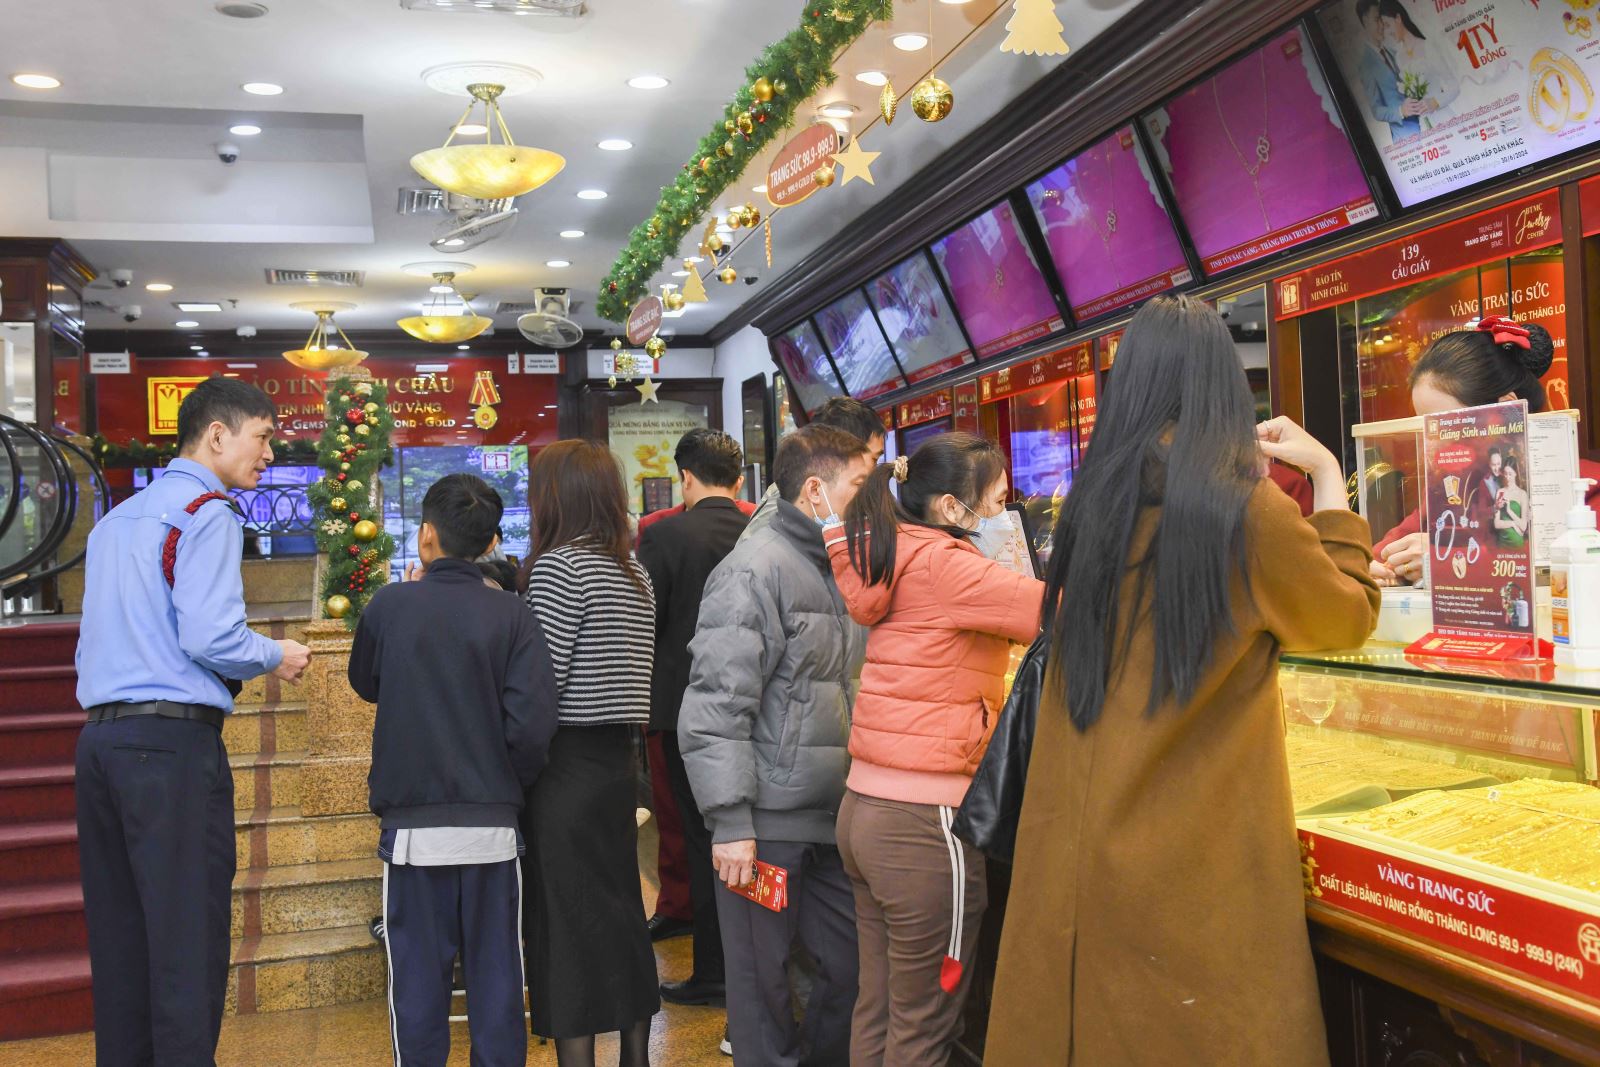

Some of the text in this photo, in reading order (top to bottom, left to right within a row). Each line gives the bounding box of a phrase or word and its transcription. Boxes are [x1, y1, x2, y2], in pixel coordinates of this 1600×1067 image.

[1479, 128, 1488, 143] 5
[1507, 137, 1525, 152] KHÁC
[770, 162, 790, 189] TRANG
[790, 153, 802, 176] SỨC
[802, 147, 815, 169] 99.9
[817, 134, 834, 159] 999.9
[1421, 147, 1440, 163] 700
[1525, 203, 1543, 214] BTMC
[1464, 230, 1503, 247] TRANG SỨC VÀNG
[1527, 231, 1544, 240] CENTER
[1401, 244, 1420, 261] 139
[1392, 255, 1431, 280] CẦU GIẤY
[1310, 287, 1329, 302] MINH
[1450, 299, 1478, 317] VÀNG
[1526, 281, 1550, 301] SỨC
[1528, 305, 1554, 320] THĂNG
[394, 372, 455, 395] CHÂU
[406, 400, 443, 414] VÀNG
[1439, 428, 1461, 441] Giáng
[1461, 426, 1479, 438] Sinh
[1487, 423, 1507, 435] Năm
[1507, 421, 1524, 434] Mới
[1491, 559, 1516, 578] 300
[1377, 862, 1496, 916] VÀNG TRANG SỨC
[1320, 873, 1340, 892] CHẤT
[1340, 880, 1358, 899] LIỆU
[1359, 883, 1382, 907] BẰNG
[1382, 892, 1407, 915] VÀNG
[1407, 900, 1435, 925] RỒNG
[1434, 911, 1468, 937] THĂNG
[1469, 923, 1498, 947] LONG
[1498, 934, 1520, 954] 99.9
[1525, 943, 1553, 966] 999.9
[1554, 952, 1584, 980] (24K)
